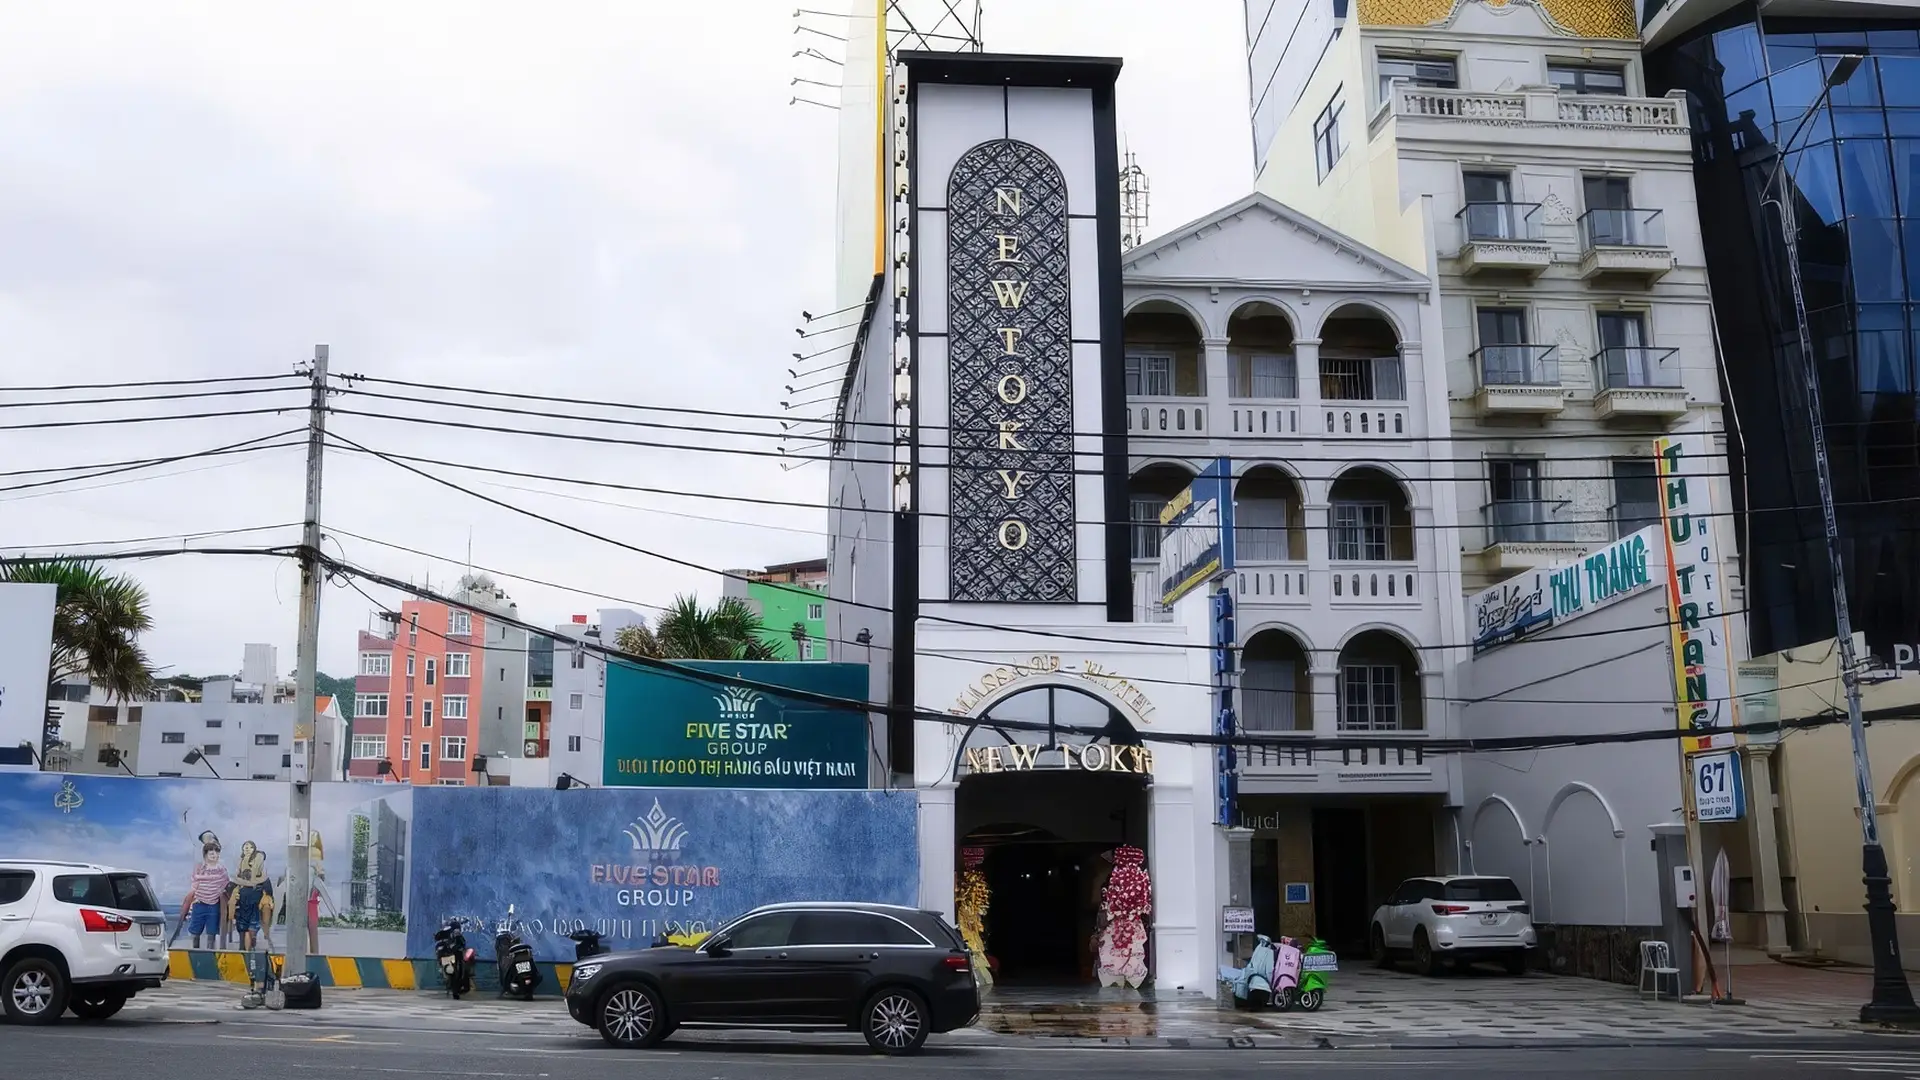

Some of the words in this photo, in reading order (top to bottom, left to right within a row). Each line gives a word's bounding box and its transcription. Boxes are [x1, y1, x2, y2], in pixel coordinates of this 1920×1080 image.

[1550, 563, 1584, 618] THU
[1585, 535, 1652, 604] TRANG
[686, 722, 731, 740] FIVE
[734, 722, 789, 740] STAR
[966, 743, 1041, 774] NEW
[1699, 761, 1725, 794] 67
[616, 888, 695, 907] GROUP
